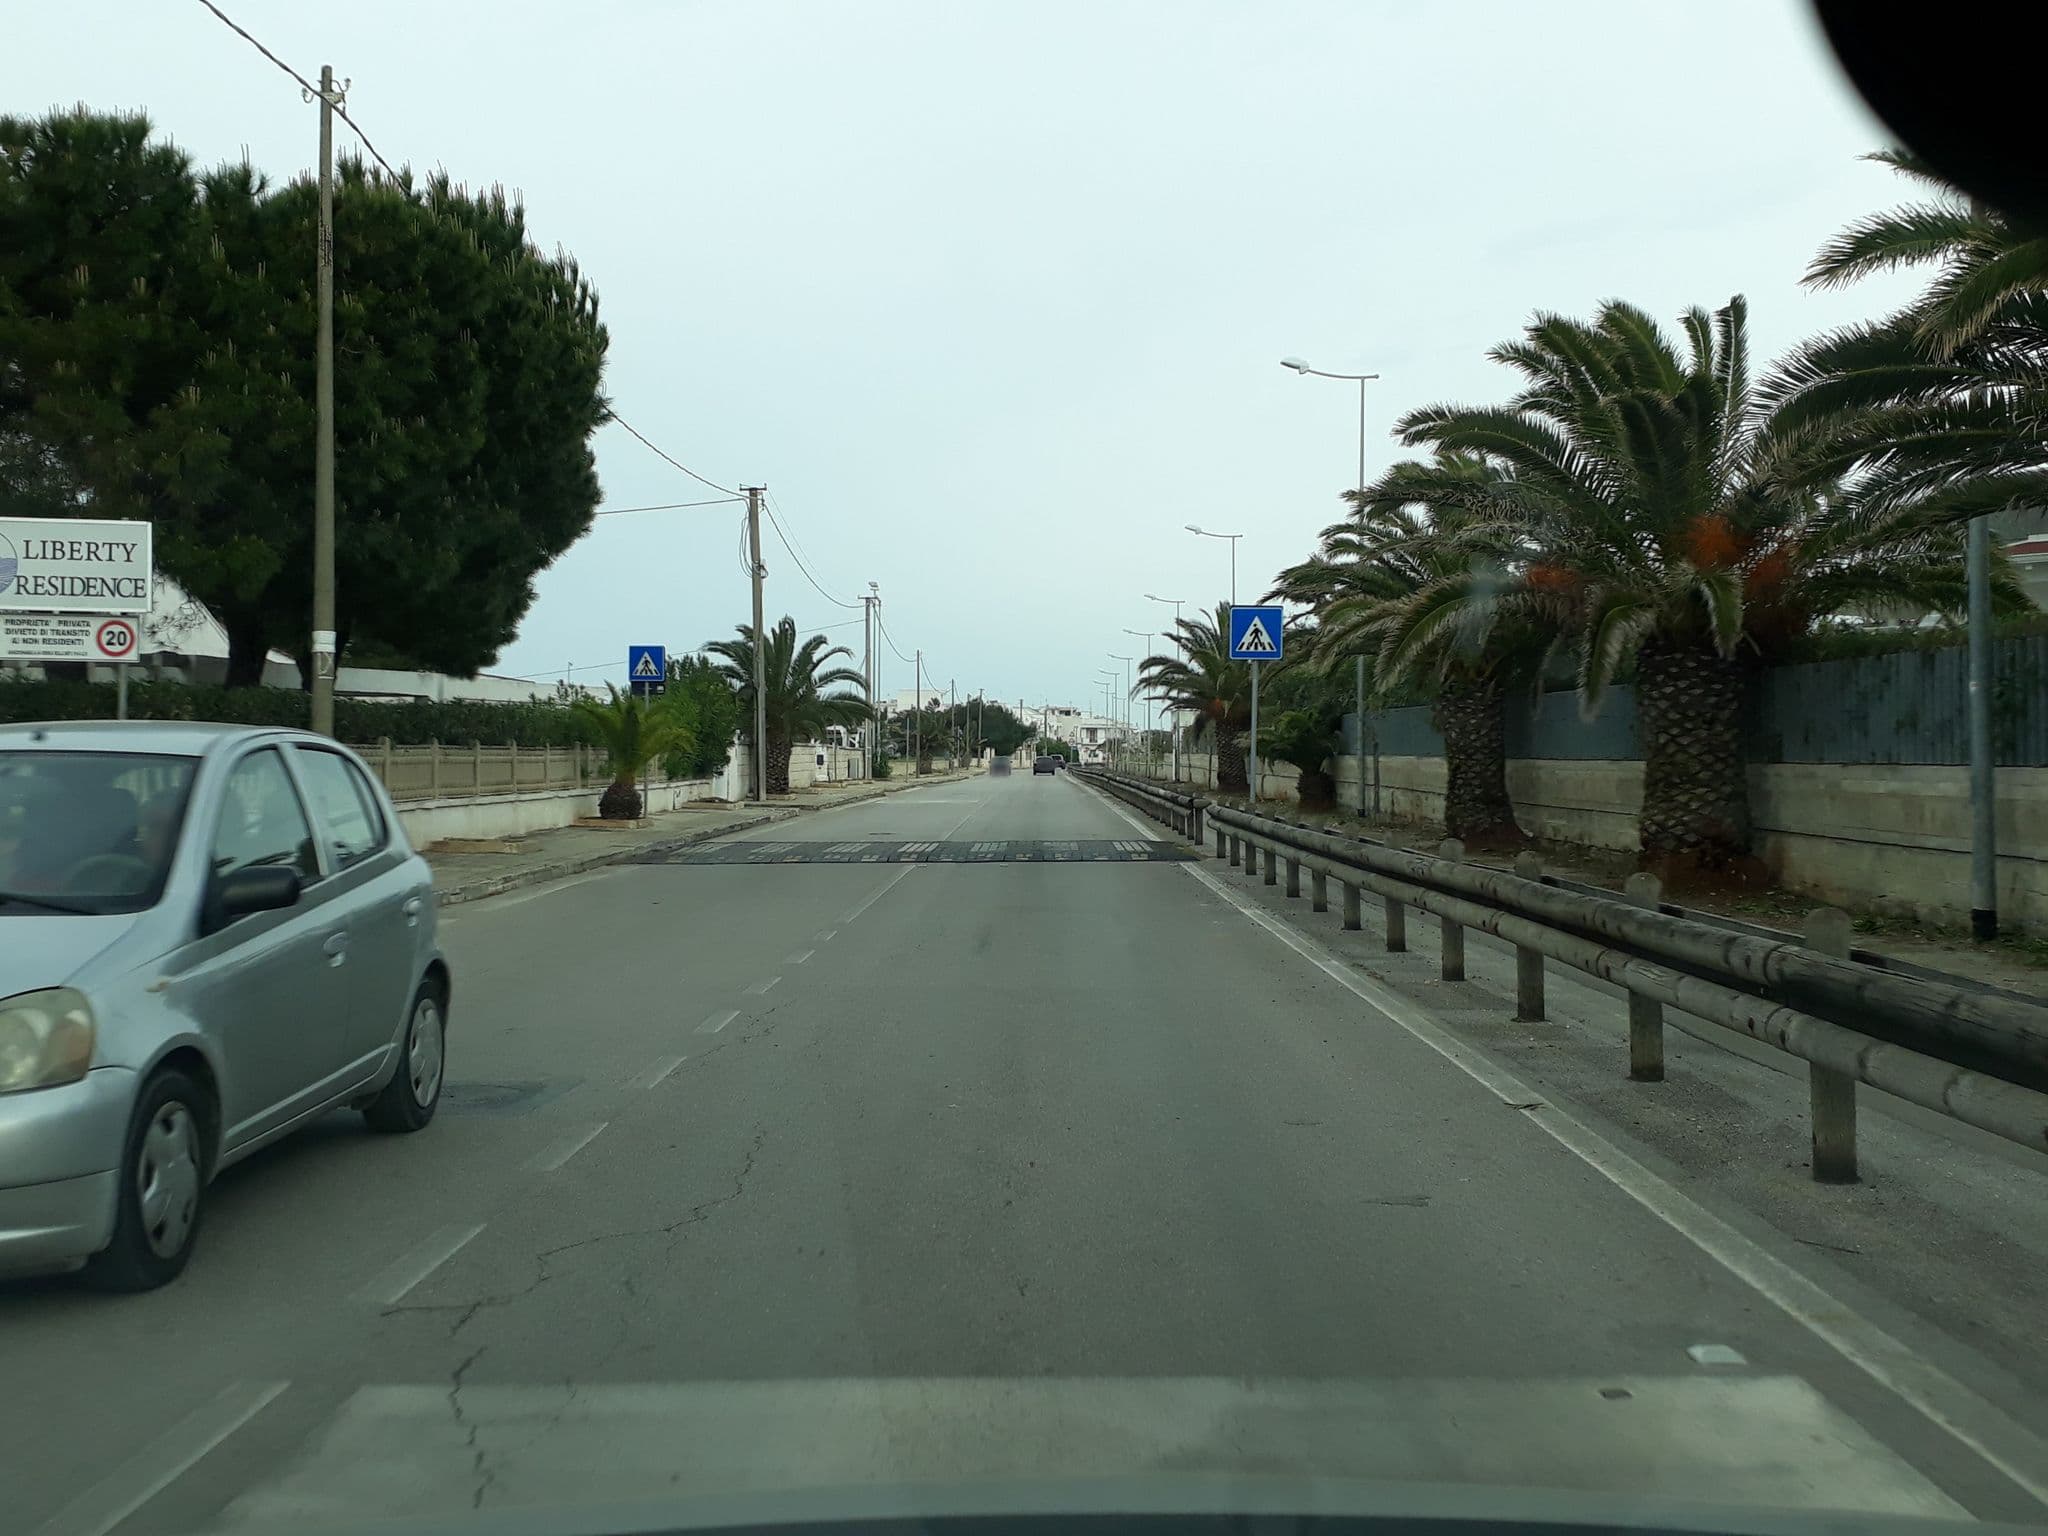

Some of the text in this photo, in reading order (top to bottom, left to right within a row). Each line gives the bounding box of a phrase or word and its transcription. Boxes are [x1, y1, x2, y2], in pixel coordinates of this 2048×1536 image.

[22, 540, 138, 563] LIBERTY
[15, 575, 147, 598] RESIDENCE
[58, 620, 91, 628] PRIVATA
[5, 628, 38, 636] DIVIETO
[51, 629, 91, 637] TRANSITO
[105, 630, 128, 646] 20
[42, 638, 85, 646] RESIDENTI
